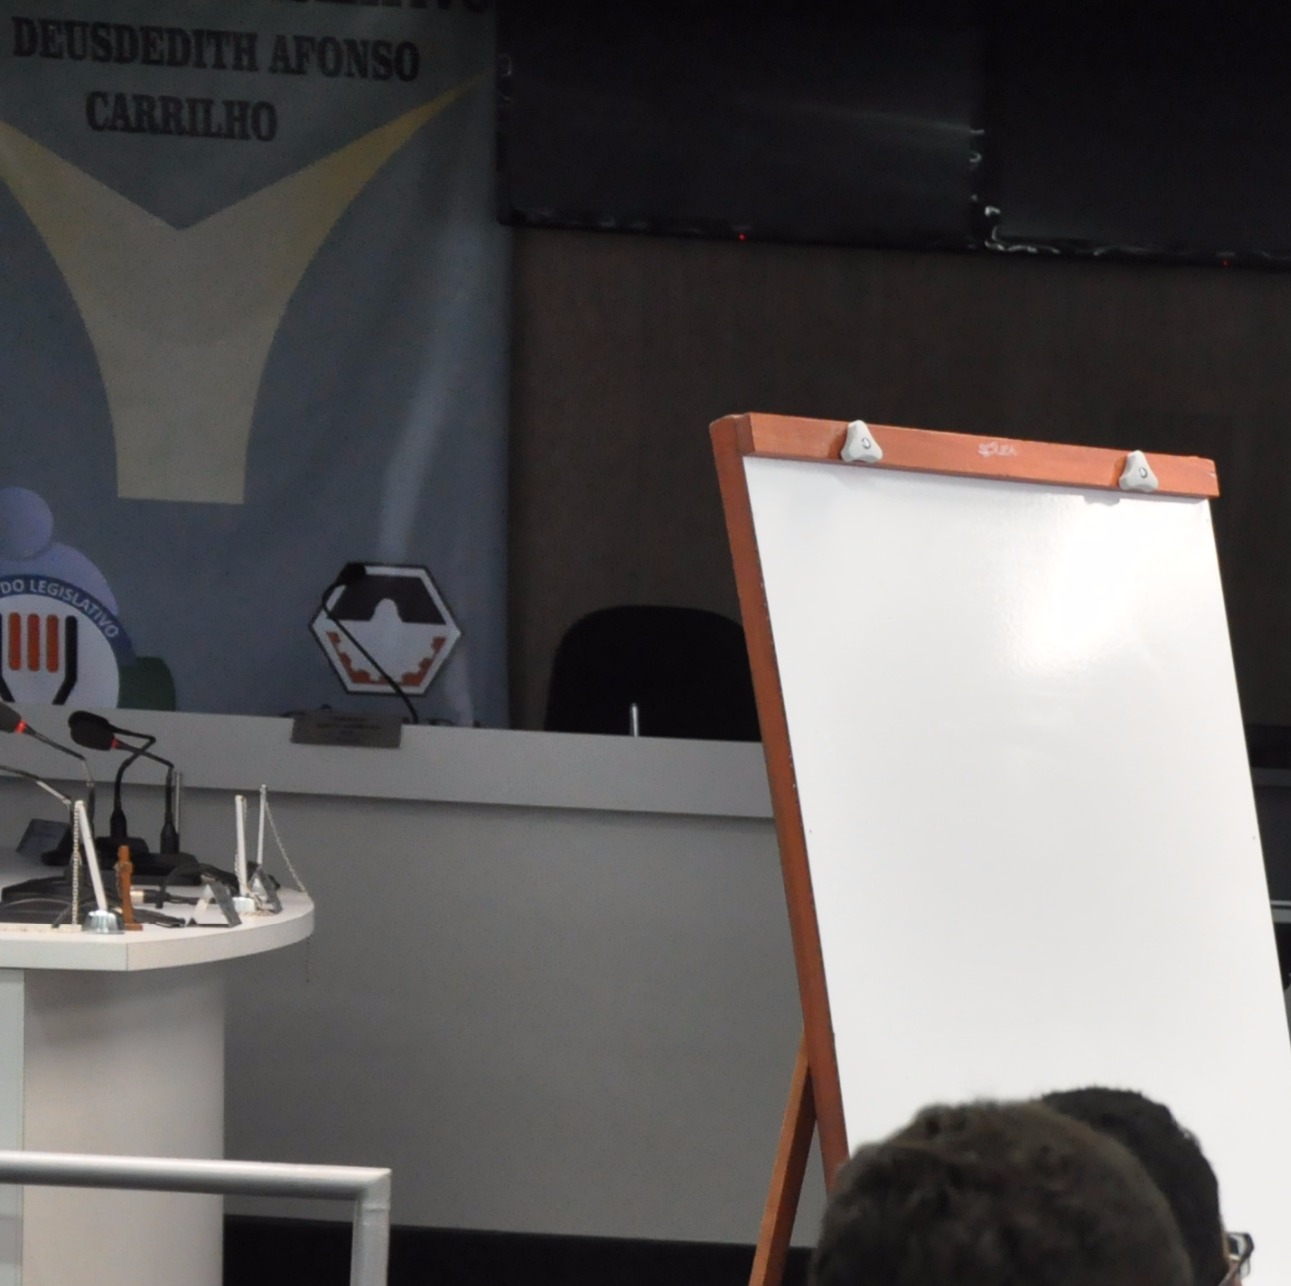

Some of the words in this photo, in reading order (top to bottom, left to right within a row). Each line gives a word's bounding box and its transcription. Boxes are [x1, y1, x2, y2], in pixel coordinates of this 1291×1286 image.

[11, 16, 259, 73] DEUSDEDITH
[268, 35, 420, 82] AFONSO
[85, 91, 278, 142] CARRILHO
[1, 579, 24, 594] DO
[30, 579, 119, 638] LEGISLATIVO
